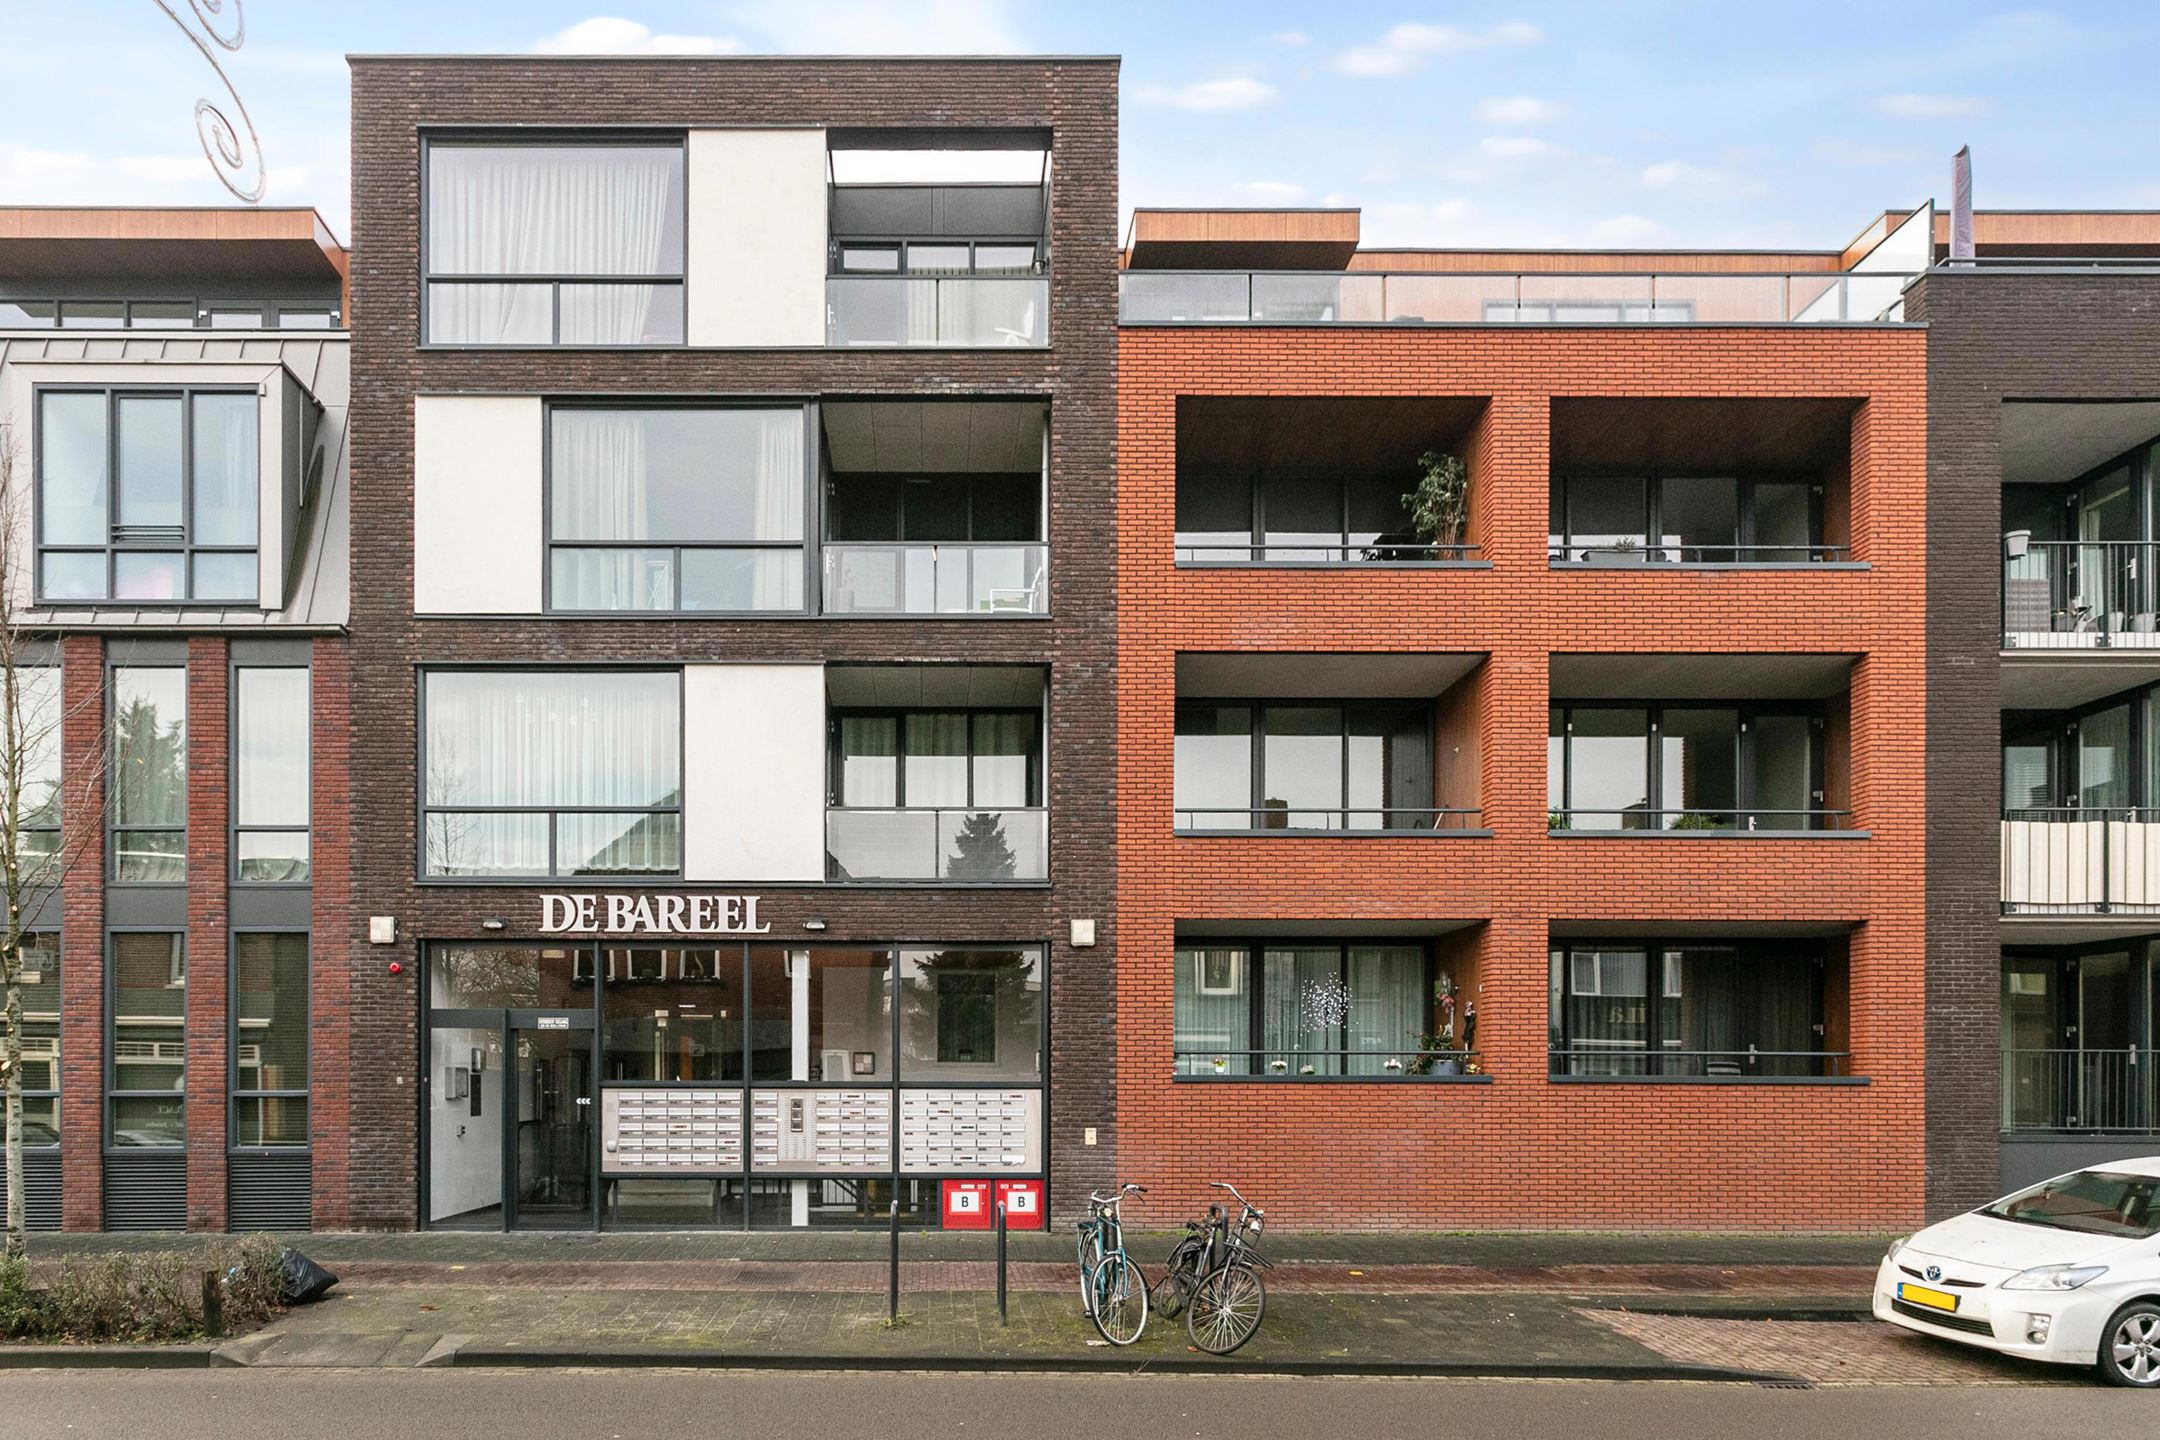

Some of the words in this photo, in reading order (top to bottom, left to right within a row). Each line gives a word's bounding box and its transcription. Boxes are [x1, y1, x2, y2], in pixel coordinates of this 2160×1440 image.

[538, 894, 599, 932] DE
[604, 894, 771, 934] BAREEL
[961, 1196, 969, 1208] B
[1017, 1196, 1026, 1208] B
